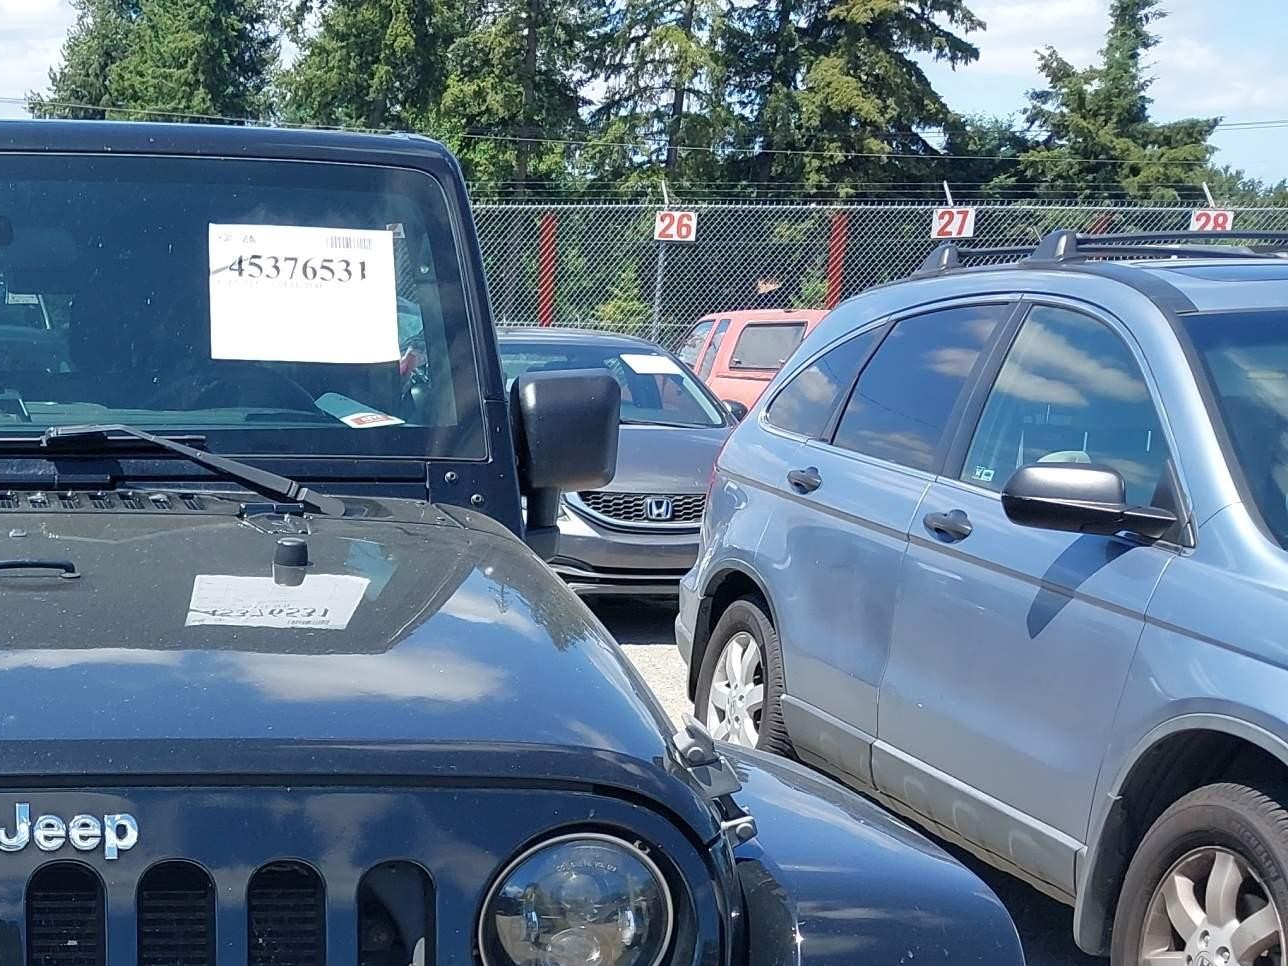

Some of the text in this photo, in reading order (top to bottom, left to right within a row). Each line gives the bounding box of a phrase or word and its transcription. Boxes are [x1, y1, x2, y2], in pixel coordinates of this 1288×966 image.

[658, 213, 692, 239] 26
[936, 210, 969, 236] 27
[1195, 212, 1229, 231] 28
[228, 254, 367, 282] 45376531
